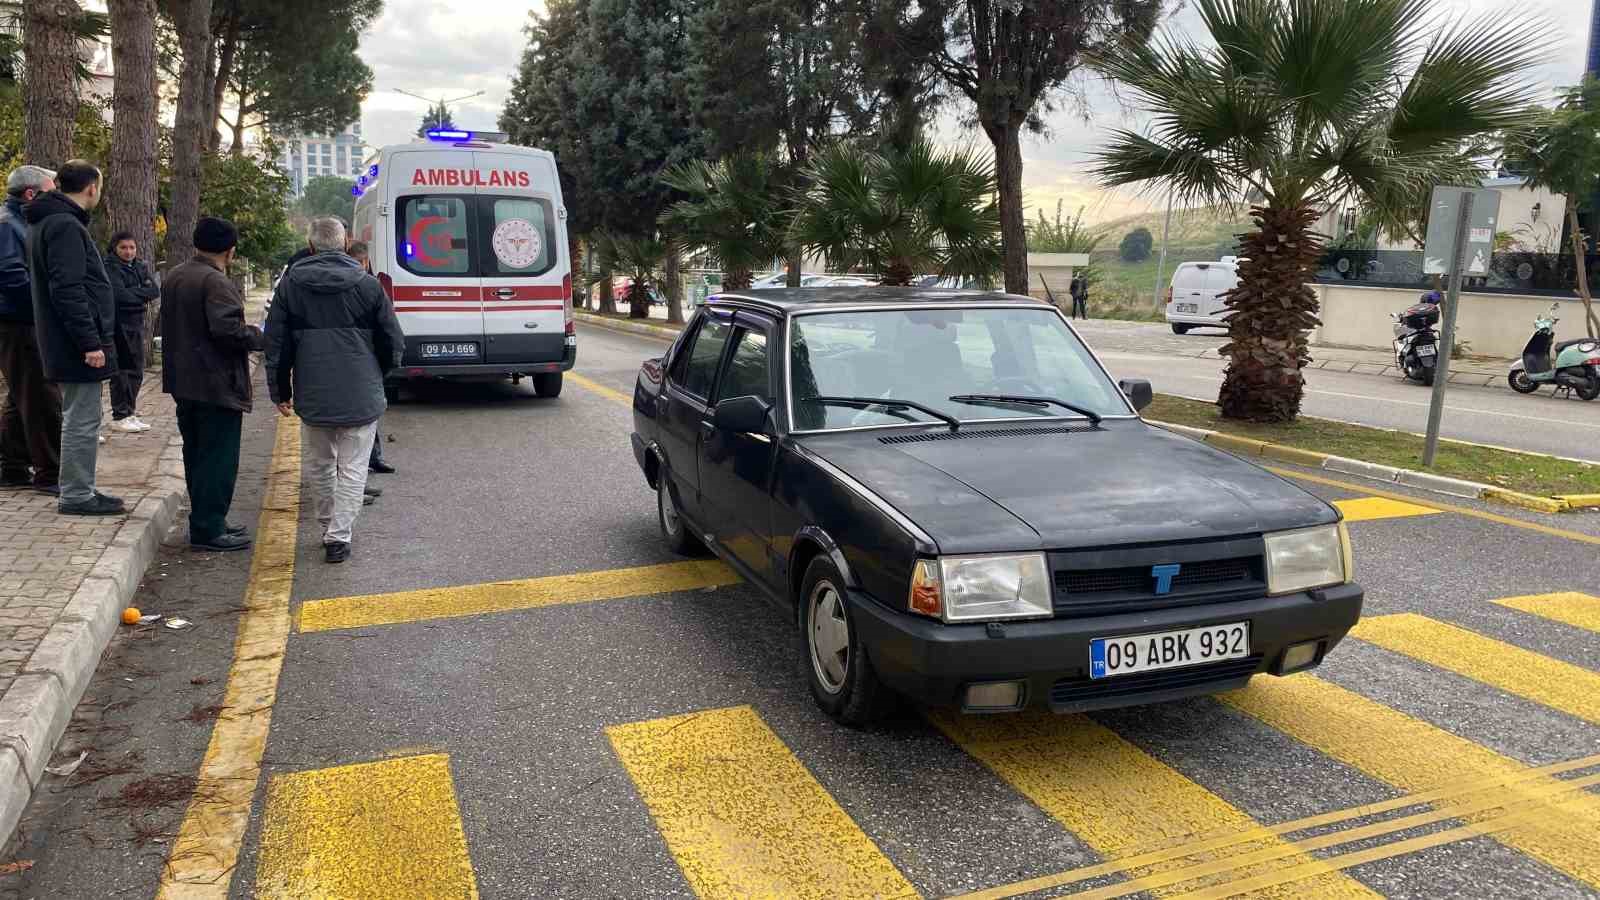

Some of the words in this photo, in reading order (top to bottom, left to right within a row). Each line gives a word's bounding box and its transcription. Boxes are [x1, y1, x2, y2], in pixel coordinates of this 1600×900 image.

[412, 168, 530, 187] AMBULANS
[426, 345, 439, 354] 09
[441, 344, 455, 354] AJ
[1093, 660, 1105, 670] TR
[1107, 641, 1137, 670] 09
[1147, 633, 1191, 665] ABK
[1200, 627, 1243, 658] 932
